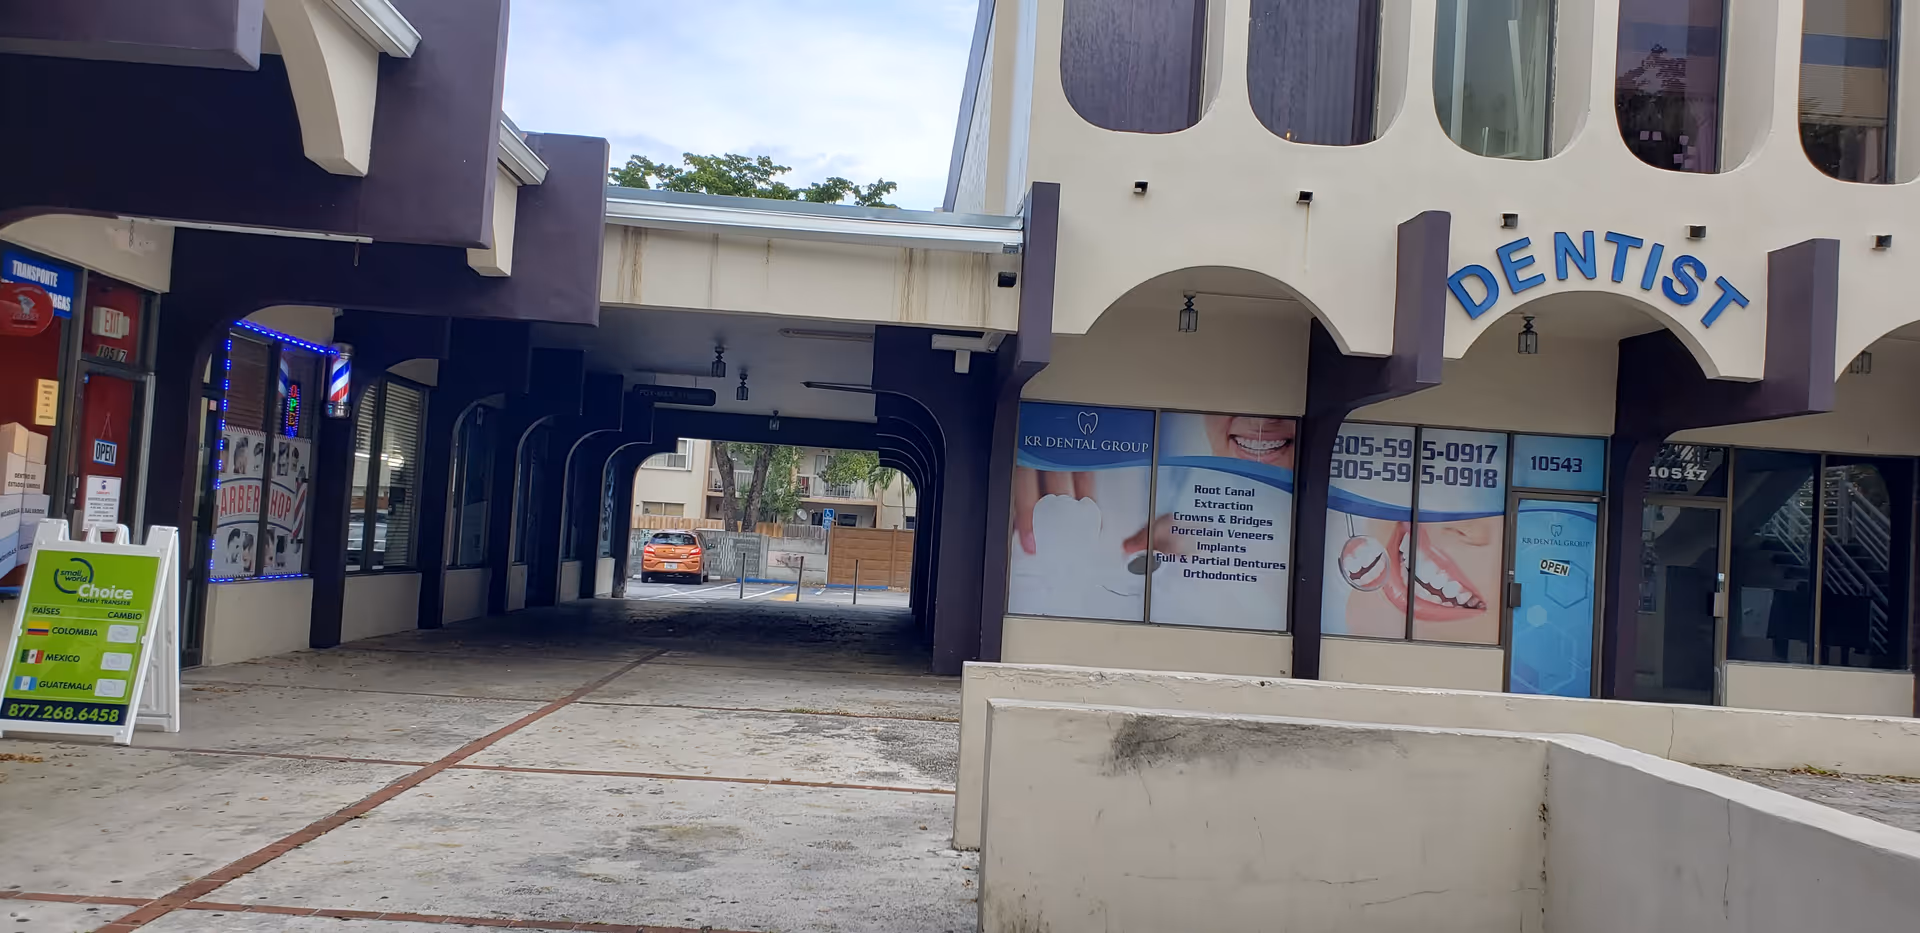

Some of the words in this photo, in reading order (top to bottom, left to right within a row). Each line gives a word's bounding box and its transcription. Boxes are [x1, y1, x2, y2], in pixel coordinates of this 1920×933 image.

[12, 260, 58, 287] TRANSPORTE
[1447, 230, 1750, 328] DENTIST
[47, 291, 71, 312] ARGAS
[105, 310, 120, 334] EXIT
[95, 442, 115, 463] OPEN
[1024, 436, 1042, 447] KR
[1046, 437, 1098, 450] DENTAL
[1101, 440, 1149, 453] GROUP
[1531, 455, 1582, 473] 10543
[1649, 466, 1707, 481] 10547
[1194, 484, 1221, 496] Root
[1225, 486, 1255, 498] Canal
[1194, 499, 1253, 512] Extraction
[1173, 512, 1214, 523] Crowns
[1218, 514, 1226, 524] &
[1230, 515, 1273, 530] Bridges
[1171, 525, 1224, 538] Porcelain
[1228, 529, 1274, 541] Veneers
[1196, 541, 1247, 554] Implants
[1534, 538, 1561, 546] DENTAL
[1564, 540, 1590, 548] GROUP
[1156, 552, 1176, 563] Full
[1179, 554, 1188, 564] &
[1192, 555, 1230, 567] Partial
[1234, 557, 1286, 570] Dentures
[1540, 559, 1569, 575] OPEN
[1183, 568, 1257, 583] Orthodontics
[79, 583, 133, 600] Choice
[32, 605, 60, 616] PAÍSES
[107, 611, 142, 620] CAMBIO
[51, 626, 98, 637] COLOMBIA
[45, 653, 80, 663] MEXICO
[39, 680, 93, 691] GUATEMALA
[8, 703, 120, 723] 877.268.6458
